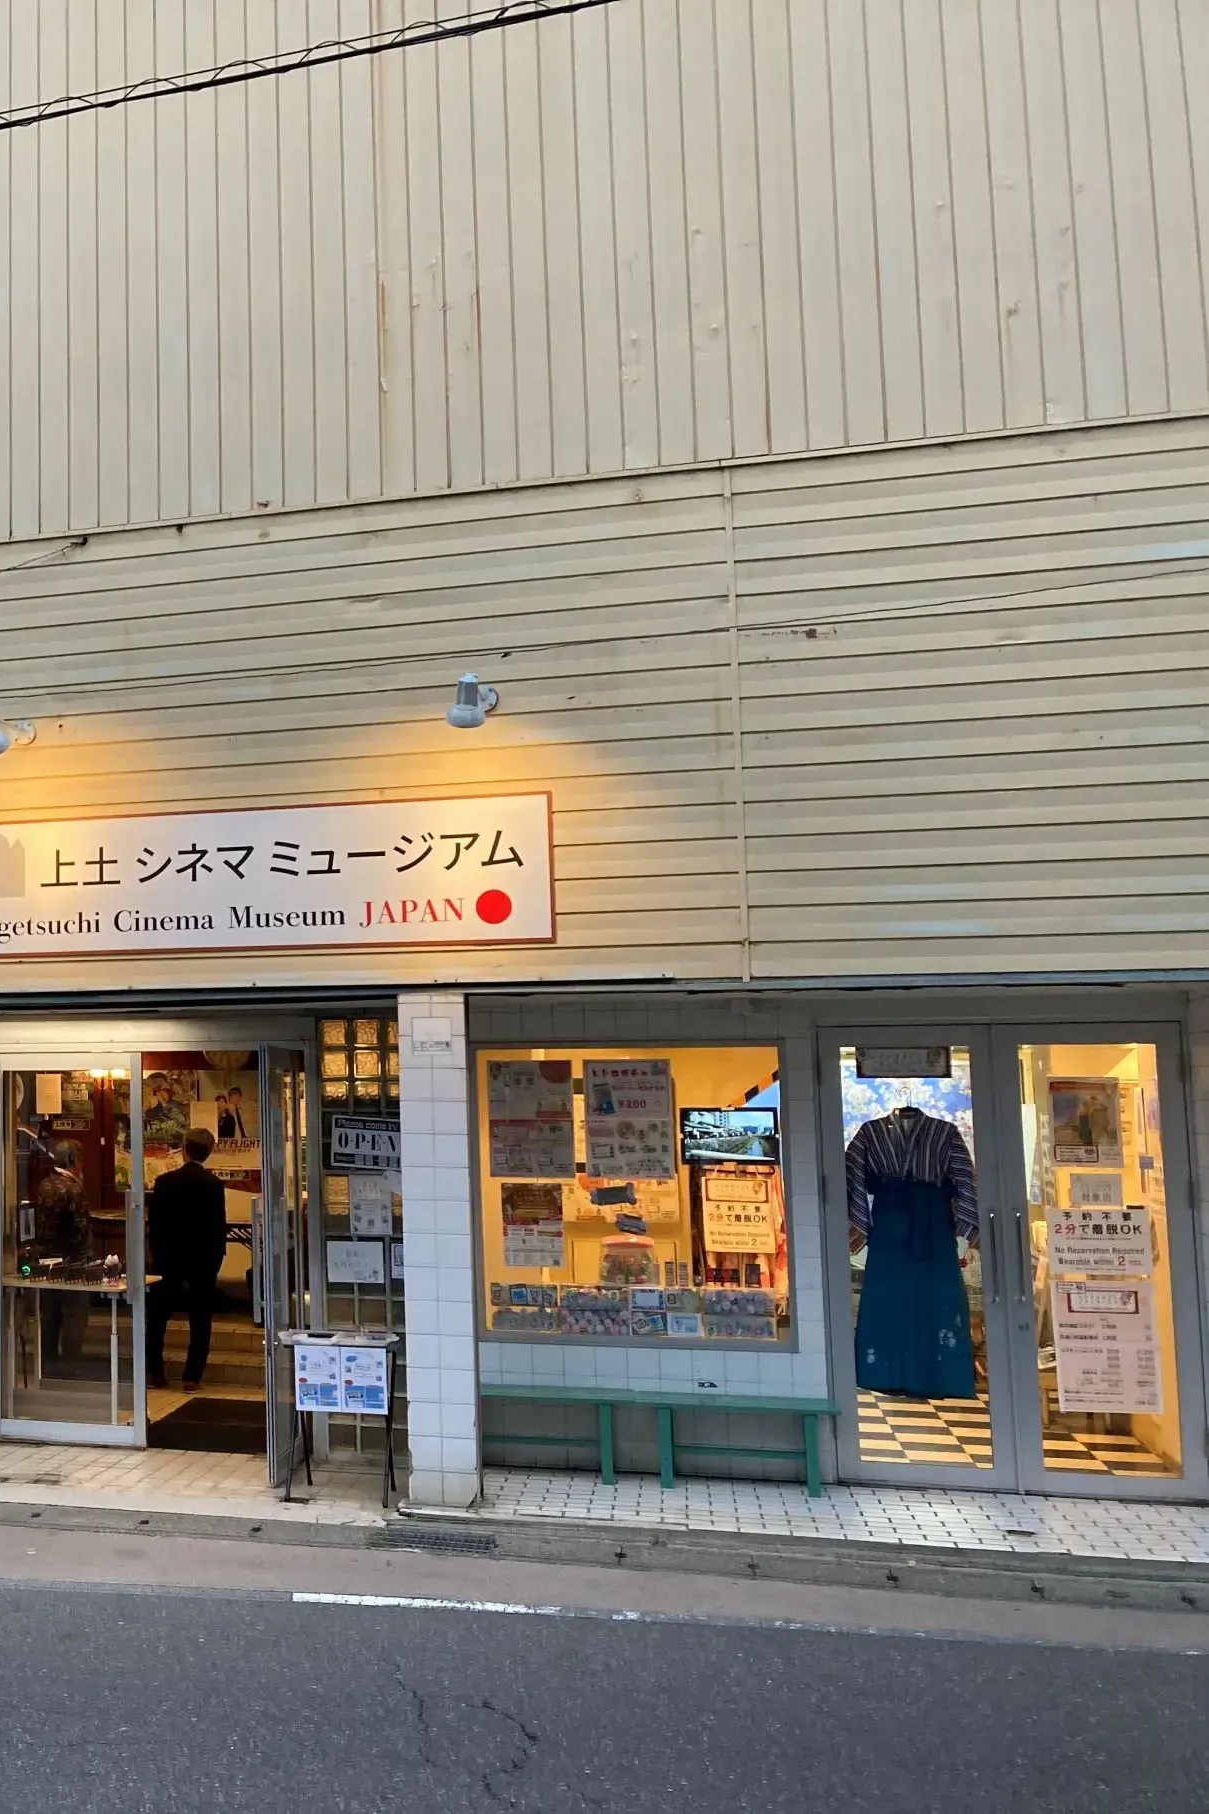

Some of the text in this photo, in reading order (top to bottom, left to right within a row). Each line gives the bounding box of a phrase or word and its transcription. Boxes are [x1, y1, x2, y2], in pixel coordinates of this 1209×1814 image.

[40, 830, 524, 887] 上土 シネマ ミュージアム
[113, 910, 215, 933] Cinema
[228, 904, 346, 930] Museum
[359, 897, 467, 928] JAPAN
[229, 1139, 262, 1149] FLIGHT
[1063, 1211, 1132, 1221] 予約不要
[1054, 1246, 1065, 1254] No
[1067, 1246, 1110, 1255] Reservation
[1117, 1255, 1127, 1266] 2
